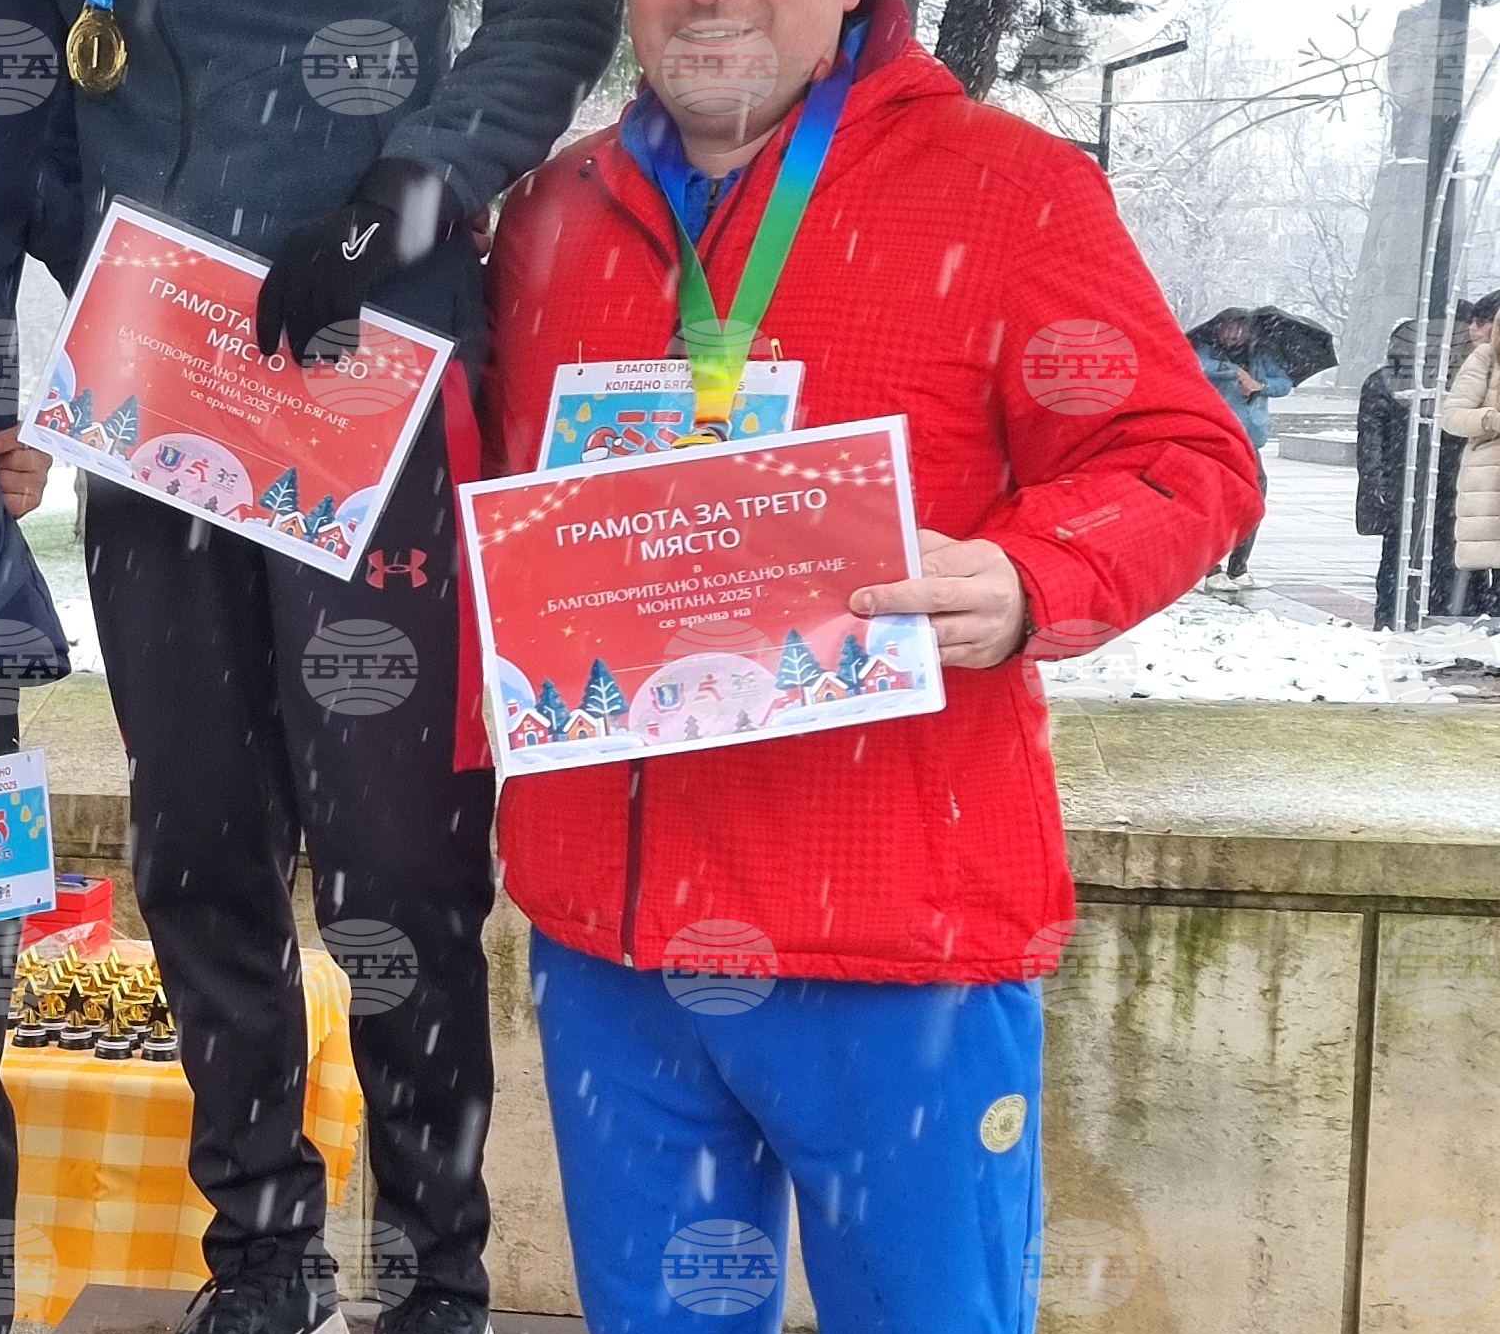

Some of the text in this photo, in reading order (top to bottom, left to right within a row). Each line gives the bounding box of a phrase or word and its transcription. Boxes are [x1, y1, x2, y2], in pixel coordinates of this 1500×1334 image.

[148, 276, 251, 335] ГРАМОТА
[118, 325, 237, 387] БЛАГОТВОРИТЕЛНО
[239, 375, 302, 412] КОЛЕДНО
[304, 404, 349, 431] БЯГАНЕ
[181, 368, 242, 405] МОНТАНА
[243, 395, 270, 415] 2025
[605, 380, 694, 392] КОЛЕДНО БЯГА
[190, 388, 261, 425] се връчва на
[555, 488, 827, 547] ГРАМОТА ЗА ТРЕТО
[641, 528, 740, 562] МЯСТО
[547, 577, 699, 614] БЛАГОТВОРИТЕЛНО
[702, 565, 785, 595] КОЛЕДНО
[788, 557, 846, 577] БЯГАНЕ
[637, 592, 715, 616] МОНТАНА
[718, 588, 751, 606] 2025
[659, 608, 751, 629] се връчва на
[0, 781, 17, 792] 2025
